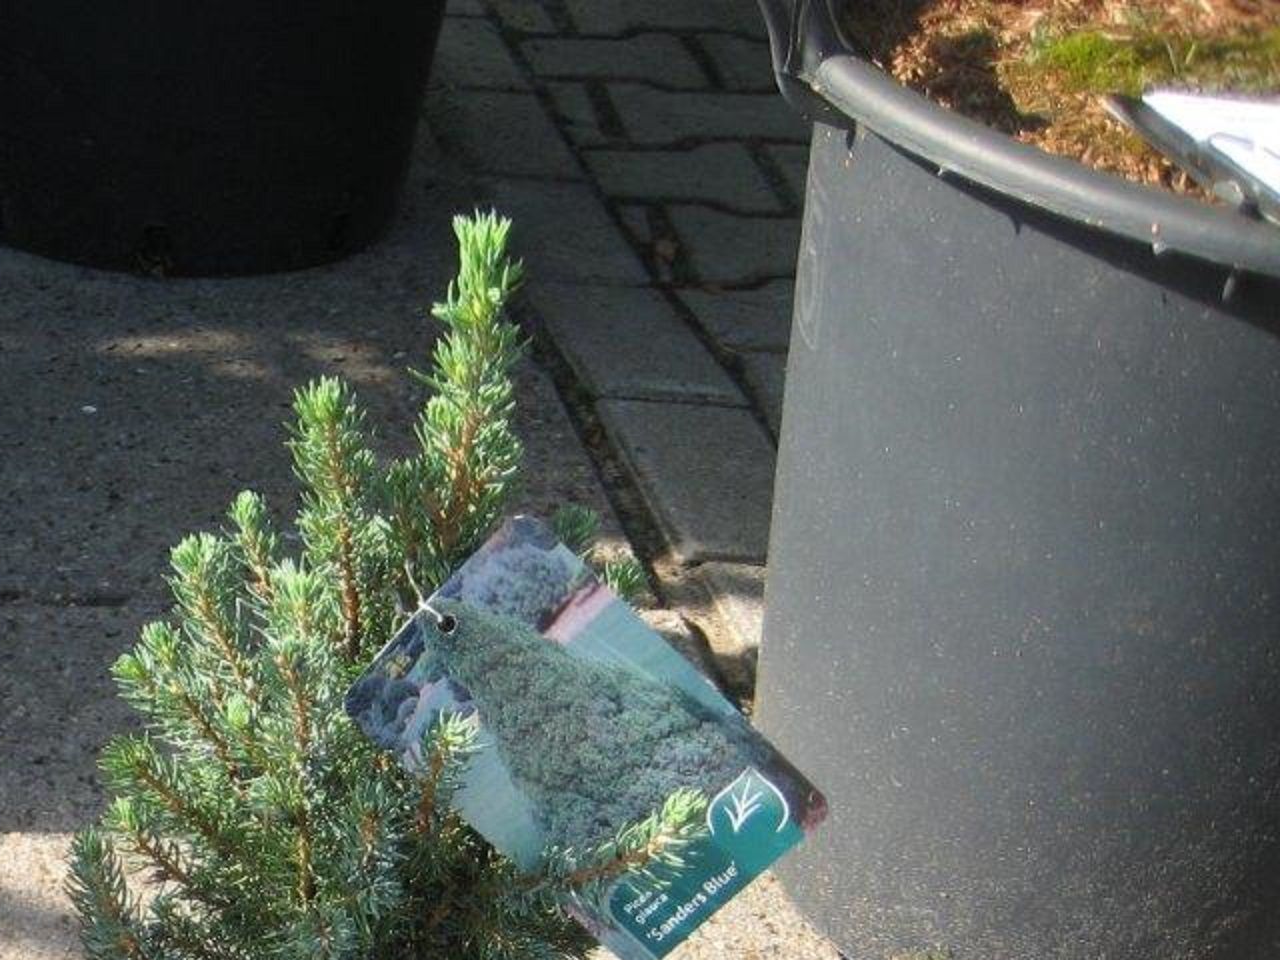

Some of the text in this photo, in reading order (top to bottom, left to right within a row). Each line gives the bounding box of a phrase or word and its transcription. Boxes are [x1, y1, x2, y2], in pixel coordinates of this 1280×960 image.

[635, 893, 669, 925] glauca
[646, 859, 738, 941] 'Sanders Blue'
